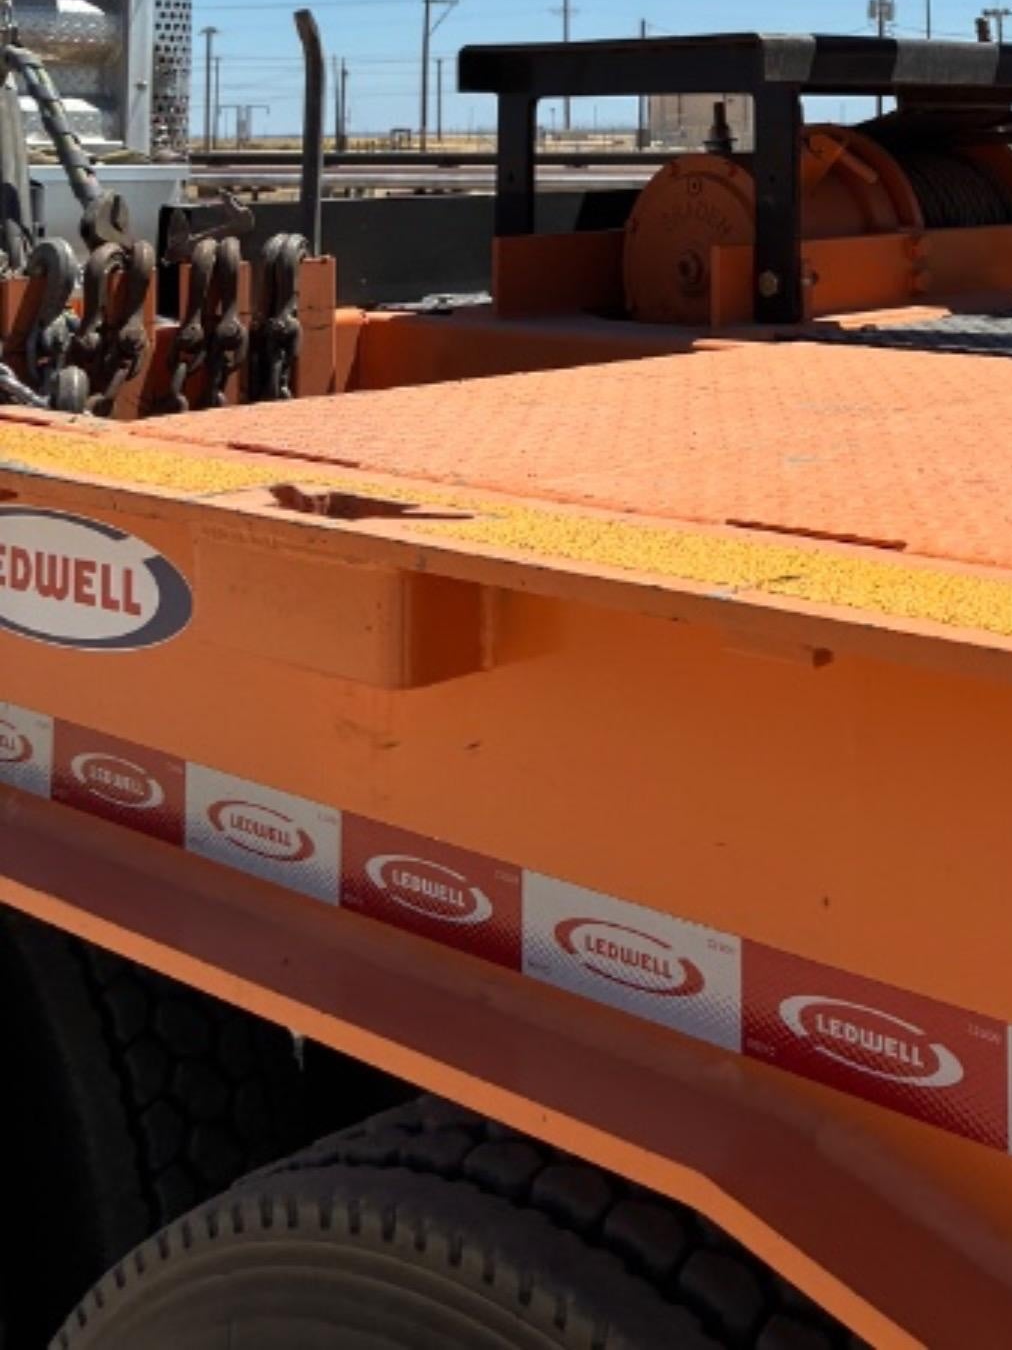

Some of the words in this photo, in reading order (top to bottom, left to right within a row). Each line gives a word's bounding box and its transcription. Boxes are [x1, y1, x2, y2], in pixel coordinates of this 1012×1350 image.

[230, 813, 292, 847] LEDWELL
[391, 869, 466, 907] LEDWELL
[585, 934, 673, 980] LEDWELL
[815, 1013, 925, 1068] LEDWELL
